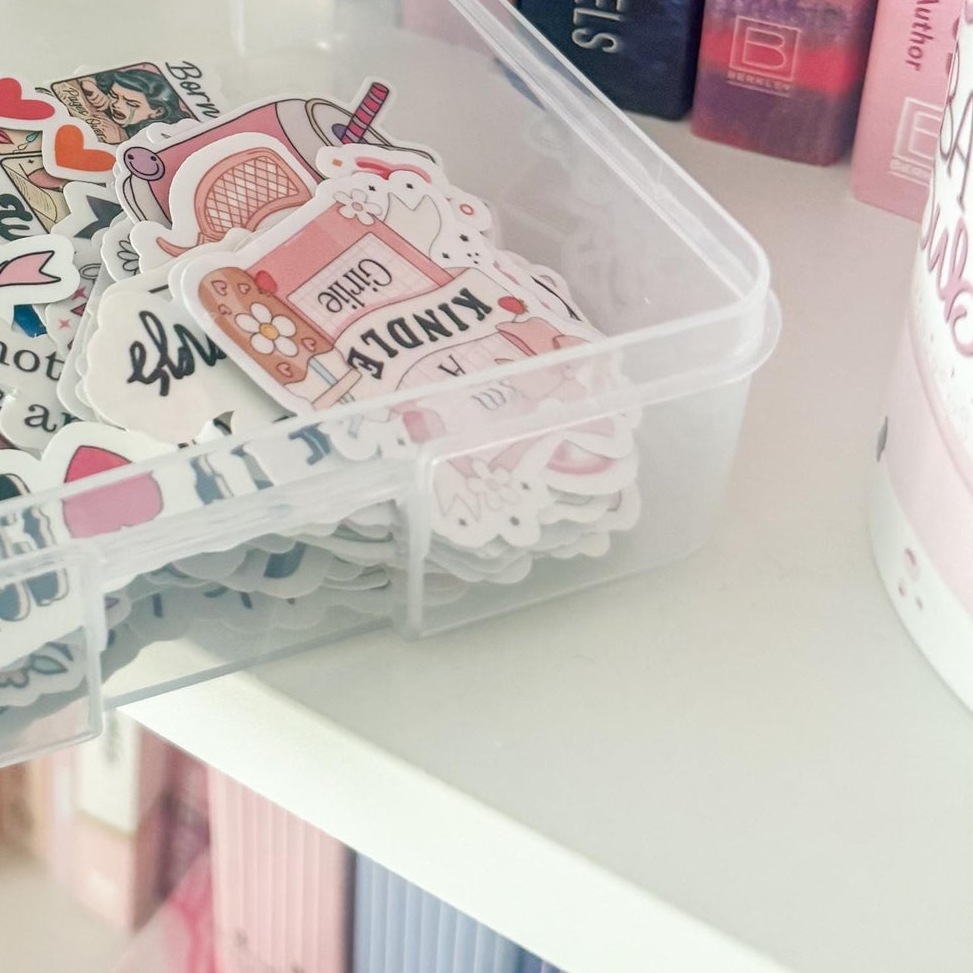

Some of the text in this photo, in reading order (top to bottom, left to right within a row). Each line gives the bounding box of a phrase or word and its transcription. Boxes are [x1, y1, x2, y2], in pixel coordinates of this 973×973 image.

[165, 60, 221, 119] Born
[727, 70, 793, 92] BERKLEY
[317, 258, 393, 314] Girlie
[346, 287, 494, 380] KINDLE
